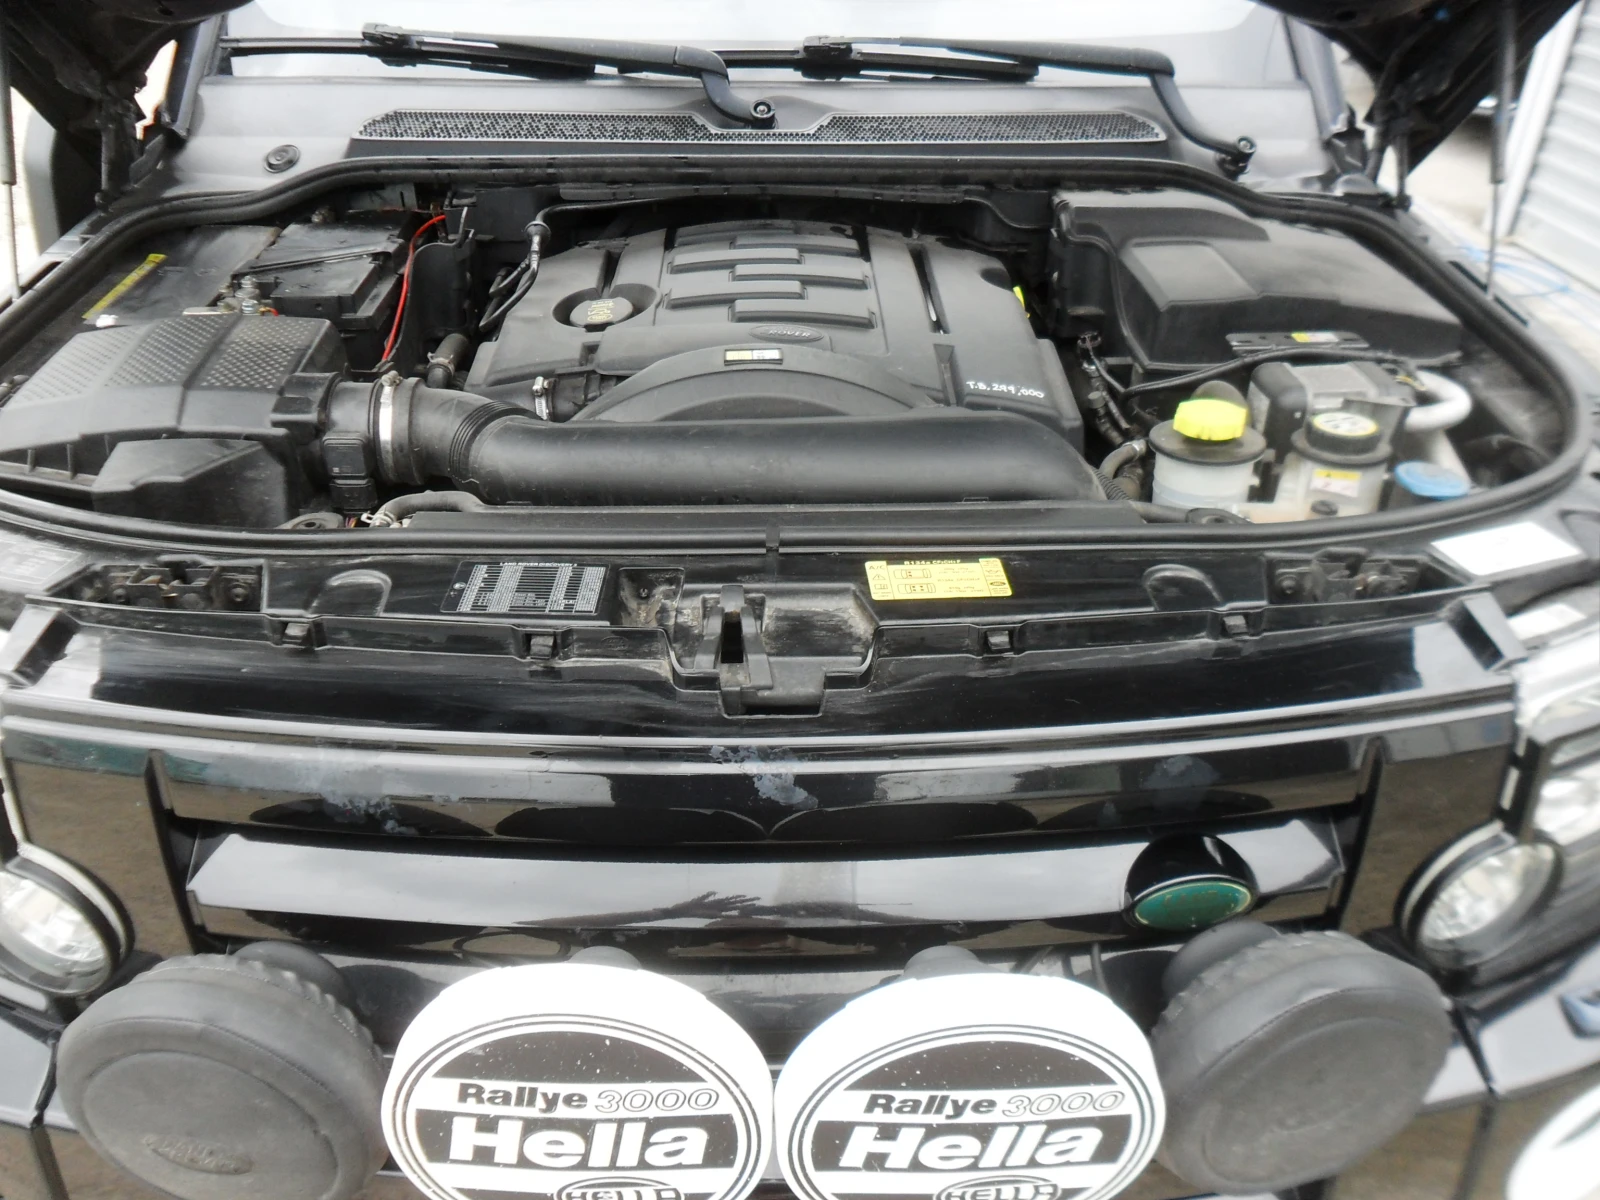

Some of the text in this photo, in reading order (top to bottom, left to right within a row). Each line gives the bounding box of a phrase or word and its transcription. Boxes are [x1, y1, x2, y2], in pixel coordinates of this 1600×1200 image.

[768, 329, 811, 338] ROVER
[457, 1082, 719, 1114] Rallye 3000
[863, 1091, 1126, 1120] Rallye 3000
[449, 1115, 709, 1168] Hella
[838, 1124, 1103, 1169] Hella
